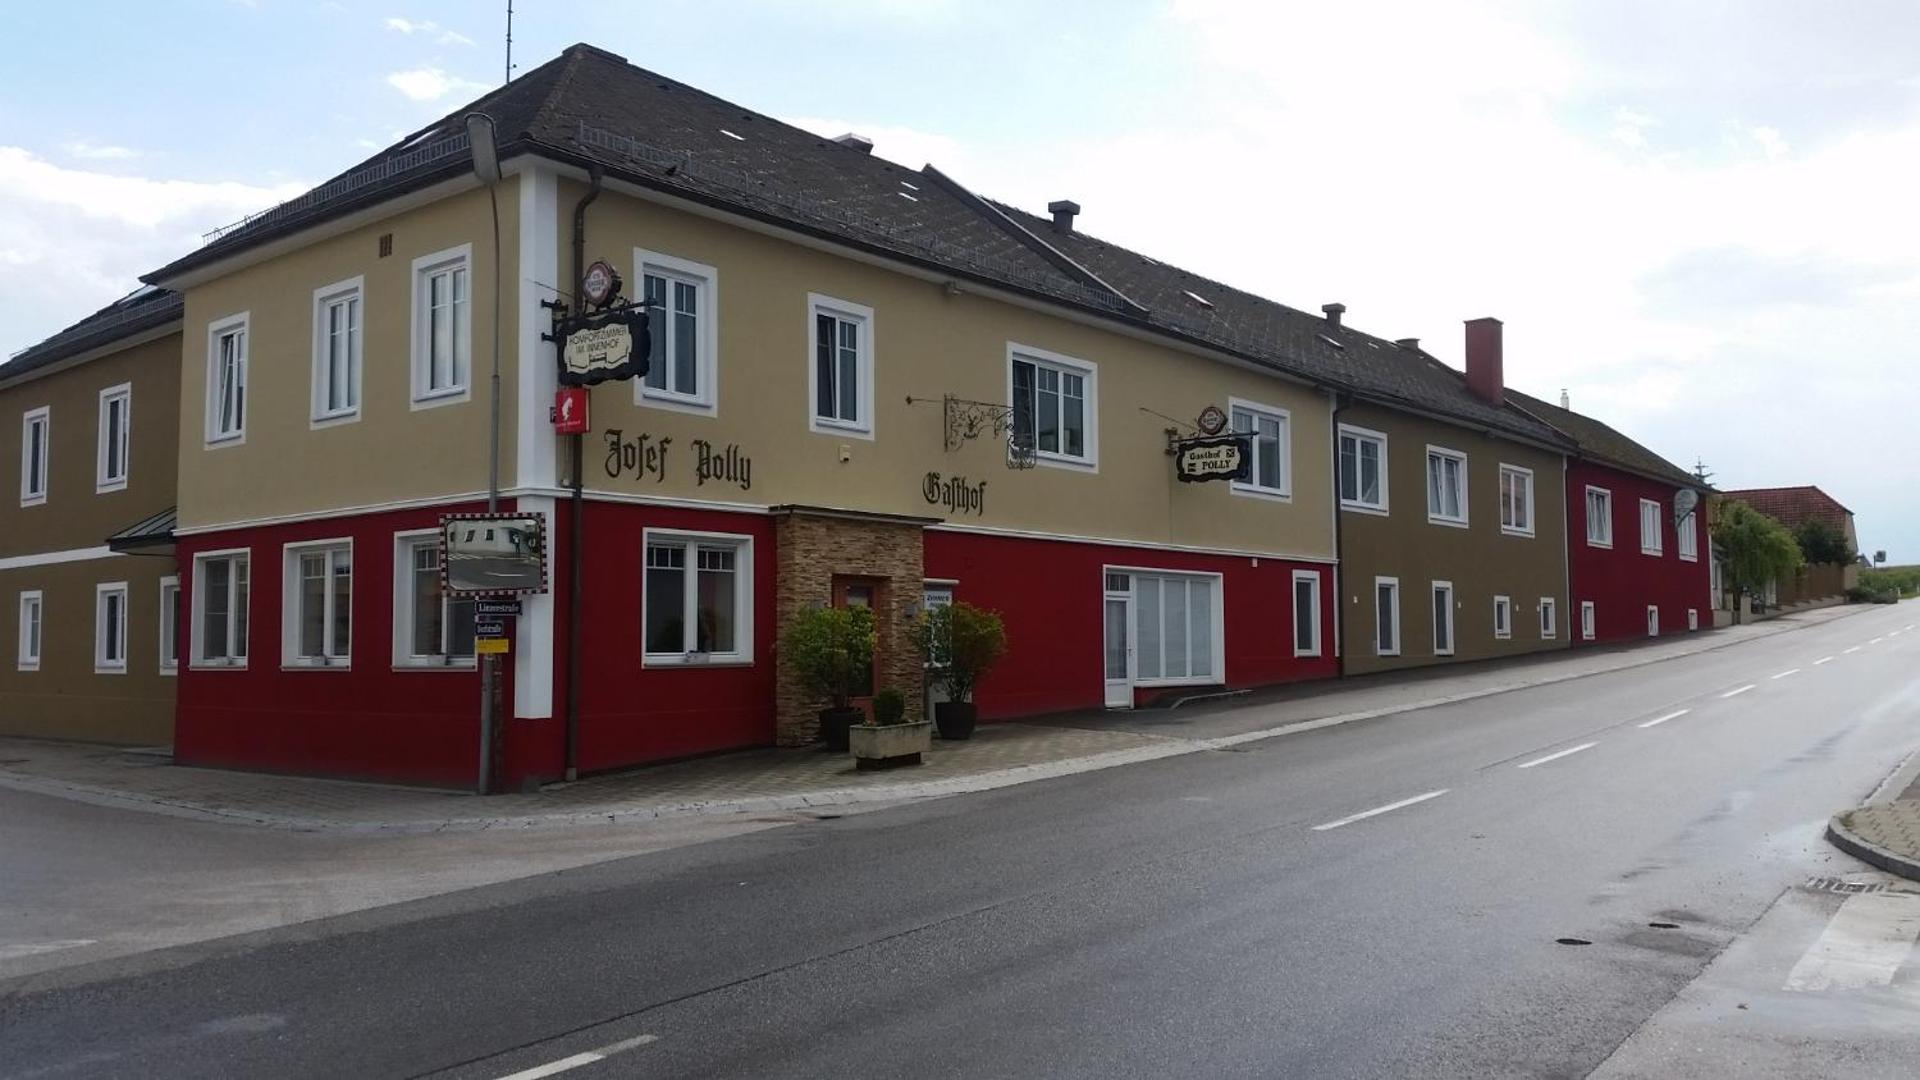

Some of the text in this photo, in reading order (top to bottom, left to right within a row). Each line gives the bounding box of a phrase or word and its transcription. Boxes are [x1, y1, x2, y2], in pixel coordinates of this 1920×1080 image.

[587, 338, 619, 352] INNENHOF
[604, 429, 751, 490] Josef Polly
[1190, 449, 1221, 460] Gasthof
[1202, 459, 1231, 470] POLLY
[922, 472, 988, 515] Gasthof
